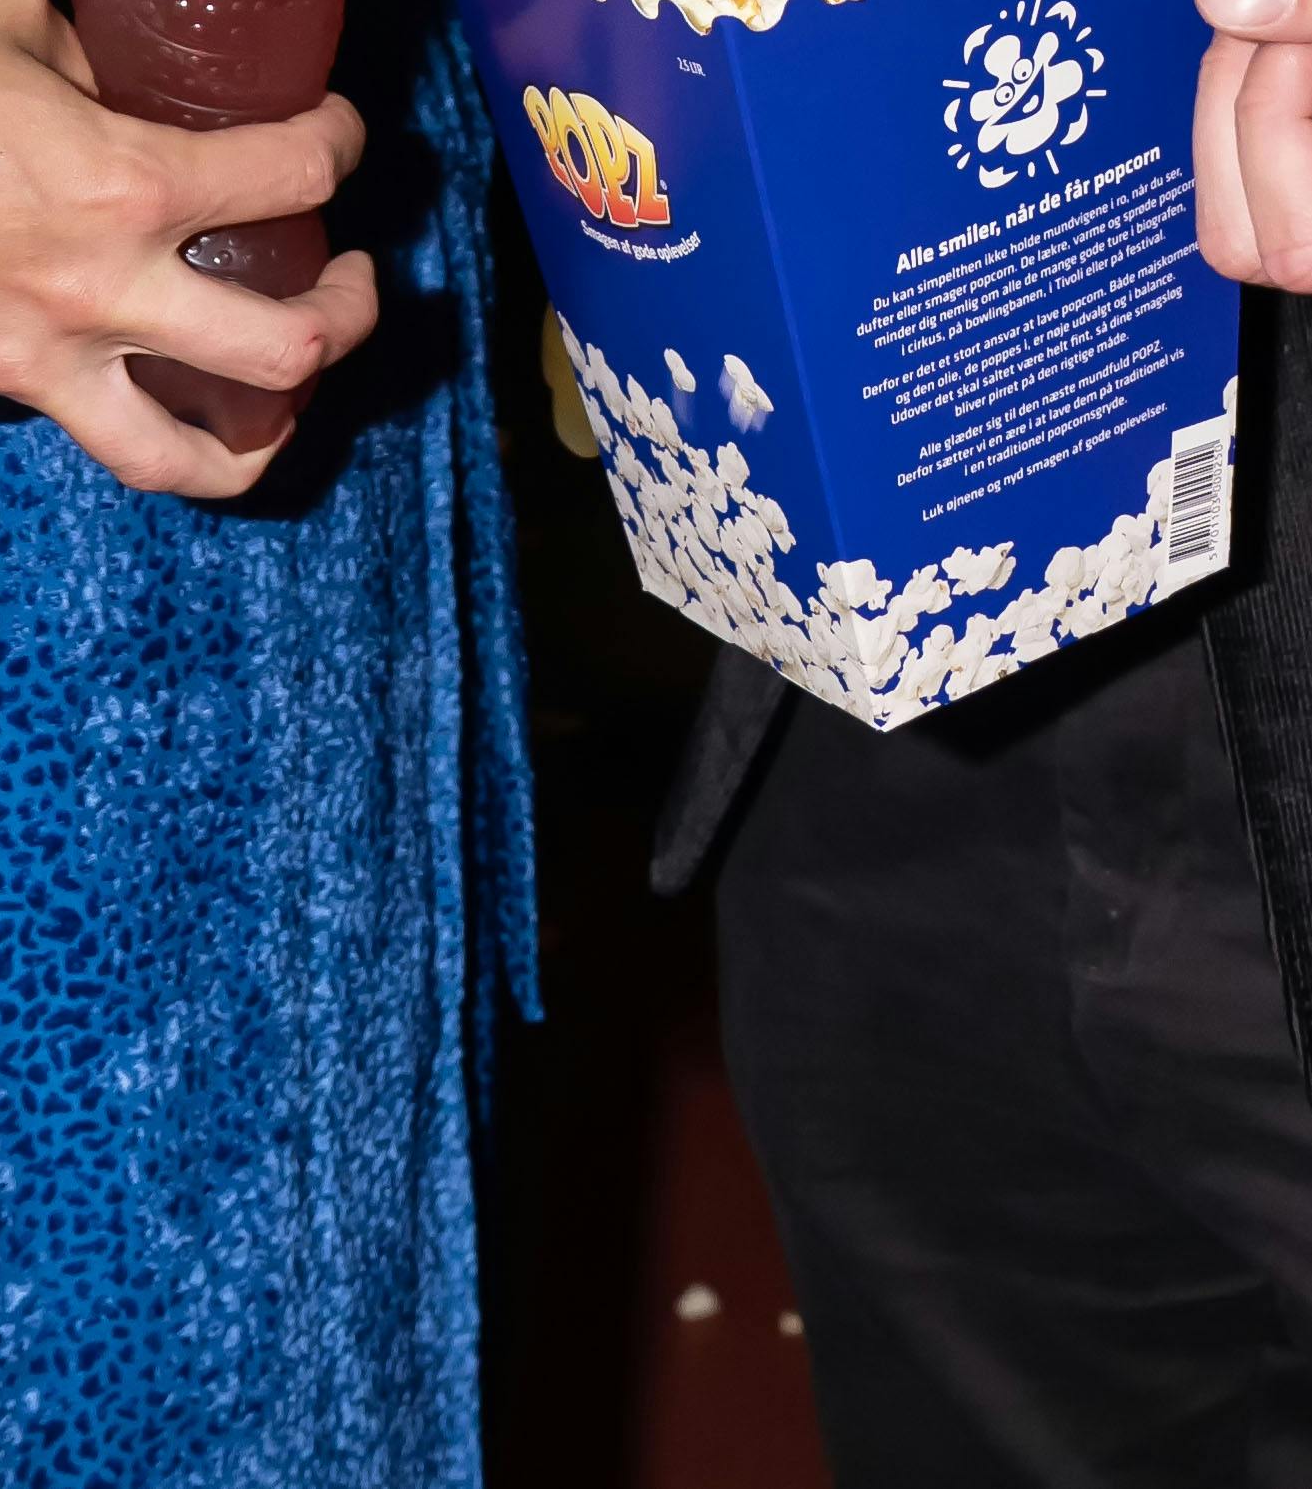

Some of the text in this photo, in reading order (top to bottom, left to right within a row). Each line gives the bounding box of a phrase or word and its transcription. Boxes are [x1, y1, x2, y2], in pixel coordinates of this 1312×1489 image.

[523, 85, 671, 228] POPZ
[896, 146, 1161, 275] Alle smiler, når de får popcorn
[581, 220, 701, 263] Smagen af gode oplevelser
[856, 314, 895, 337] dufter
[896, 302, 923, 321] eller
[924, 284, 967, 310] smager
[1020, 255, 1035, 269] De
[1037, 241, 1071, 262] lækre,
[1072, 223, 1106, 245] varme
[1107, 215, 1121, 229] og
[1123, 198, 1157, 222] sprøde
[873, 297, 890, 312] Du
[892, 287, 915, 304] kan
[917, 259, 983, 294] simpelthen
[984, 248, 1008, 266] ikke
[1010, 234, 1041, 255] holde
[1043, 203, 1109, 241] mundvigene
[1116, 194, 1129, 207] ro,
[1131, 183, 1149, 200] når
[1150, 176, 1163, 190] du
[1165, 167, 1183, 183] ser,
[874, 323, 917, 348] minder
[918, 315, 937, 331] dig
[939, 297, 979, 322] nemlig
[980, 289, 999, 305] om
[1002, 279, 1022, 296] alle
[1024, 272, 1039, 286] de
[1040, 255, 1077, 279] mange
[1079, 241, 1105, 264] gode
[1107, 230, 1129, 248] ture
[1136, 203, 1186, 234] biografen,
[907, 331, 945, 354] cirkus,
[948, 321, 963, 340] på
[965, 288, 1047, 330] bowlingbanen,
[1054, 267, 1084, 290] Tivoli
[1085, 258, 1109, 277] eller
[1110, 249, 1124, 268] på
[1125, 229, 1166, 257] festival.
[863, 377, 900, 400] Derfor
[902, 371, 914, 384] er
[916, 361, 936, 378] det
[938, 355, 951, 369] et
[953, 342, 981, 363] stort
[983, 326, 1021, 350] ansvar
[1023, 318, 1035, 333] at
[1037, 309, 1060, 327] lave
[1109, 273, 1136, 293] Både
[891, 285, 1183, 425] Udover det skal saltet være helt fint, så dine smagsløg
[895, 391, 911, 405] og
[913, 381, 935, 398] den
[937, 371, 961, 388] olie,
[964, 362, 979, 377] de
[981, 344, 1022, 373] poppes
[1033, 333, 1045, 346] er
[1046, 322, 1070, 340] nøje
[1072, 301, 1112, 329] udvalgt
[1113, 295, 1127, 309] og
[1134, 272, 1176, 299] balance.
[919, 339, 1163, 460] Alle glæder sig til den næste mundfuld POPZ.
[955, 332, 1129, 417] bliver pirret på den rigtige måde.
[897, 464, 933, 487] Derfor
[935, 446, 975, 470] sætter
[975, 438, 986, 453] vi
[988, 434, 1003, 448] en
[1005, 423, 1027, 441] ære
[1035, 413, 1047, 427] at
[1049, 403, 1071, 421] lave
[1073, 391, 1097, 410] dem
[1099, 382, 1113, 400] på
[1114, 353, 1169, 390] traditionel
[1169, 348, 1185, 362] vis
[922, 402, 1167, 522] Luk øjnene og nyd smagen af gode oplevelser.
[970, 460, 985, 474] en
[987, 430, 1045, 466] traditionel
